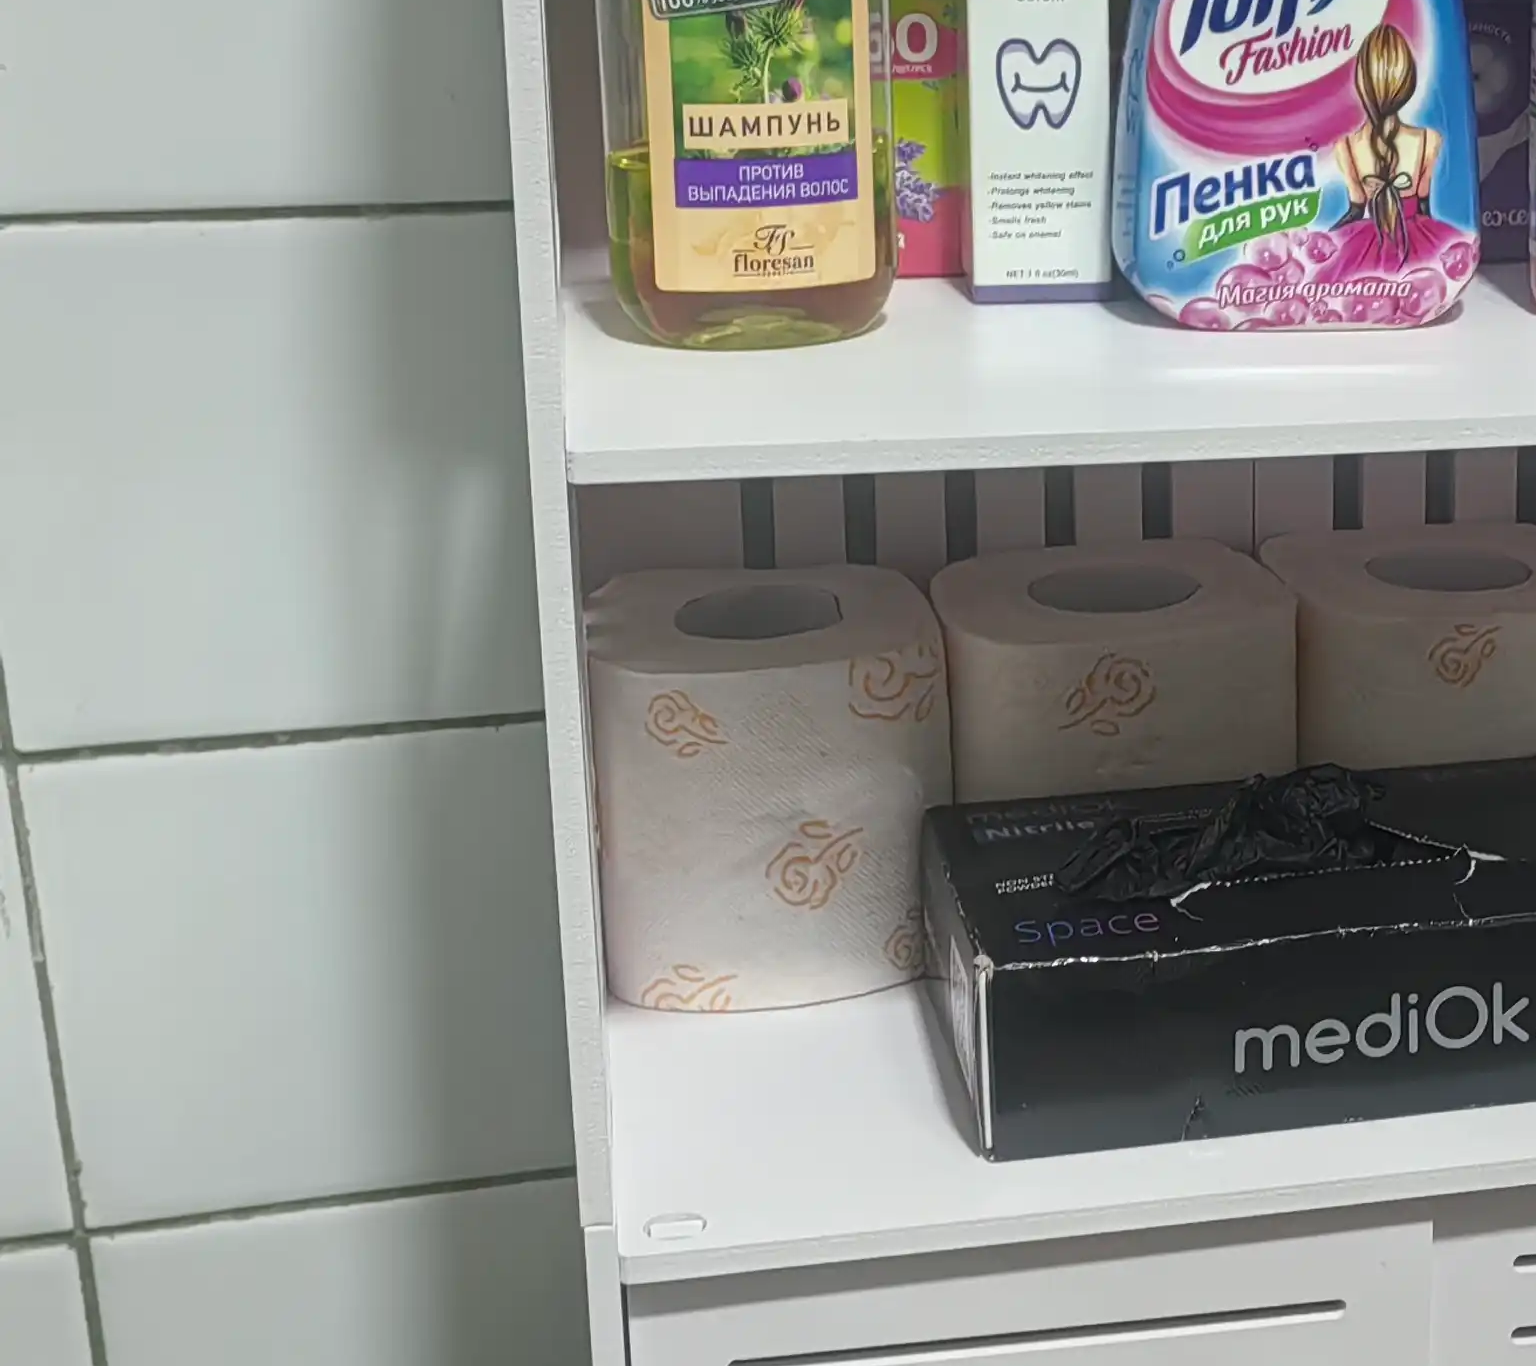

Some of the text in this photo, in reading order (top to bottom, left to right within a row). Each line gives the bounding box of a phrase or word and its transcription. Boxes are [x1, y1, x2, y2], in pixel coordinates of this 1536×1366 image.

[1218, 22, 1355, 86] Fashion
[688, 110, 842, 139] ШАМПУНЬ
[738, 162, 805, 183] ПРОТИВ
[687, 178, 850, 204] ВЫПАДЕНИЯ ВОЛОС
[1152, 153, 1317, 236] Пенка
[1198, 195, 1311, 246] для рук
[734, 253, 815, 273] floresan
[1219, 277, 1412, 312] Магия аромата
